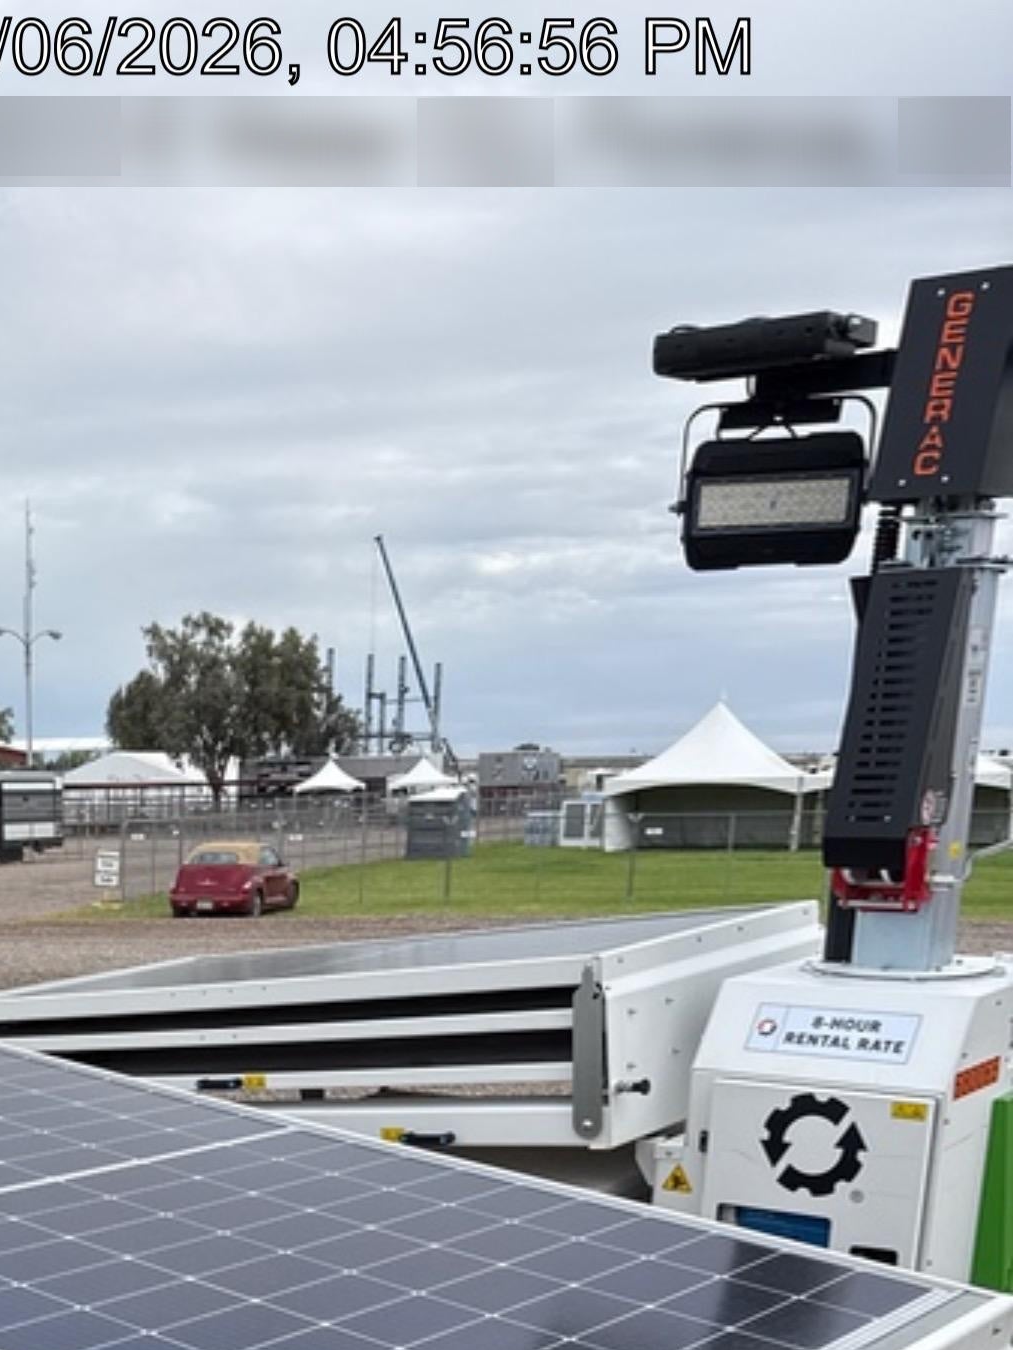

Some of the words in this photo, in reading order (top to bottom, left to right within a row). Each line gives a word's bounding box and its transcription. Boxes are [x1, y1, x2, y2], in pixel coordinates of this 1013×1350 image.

[913, 290, 976, 476] GENERAC
[782, 1031, 851, 1051] RENTAL
[856, 1037, 907, 1054] RATE
